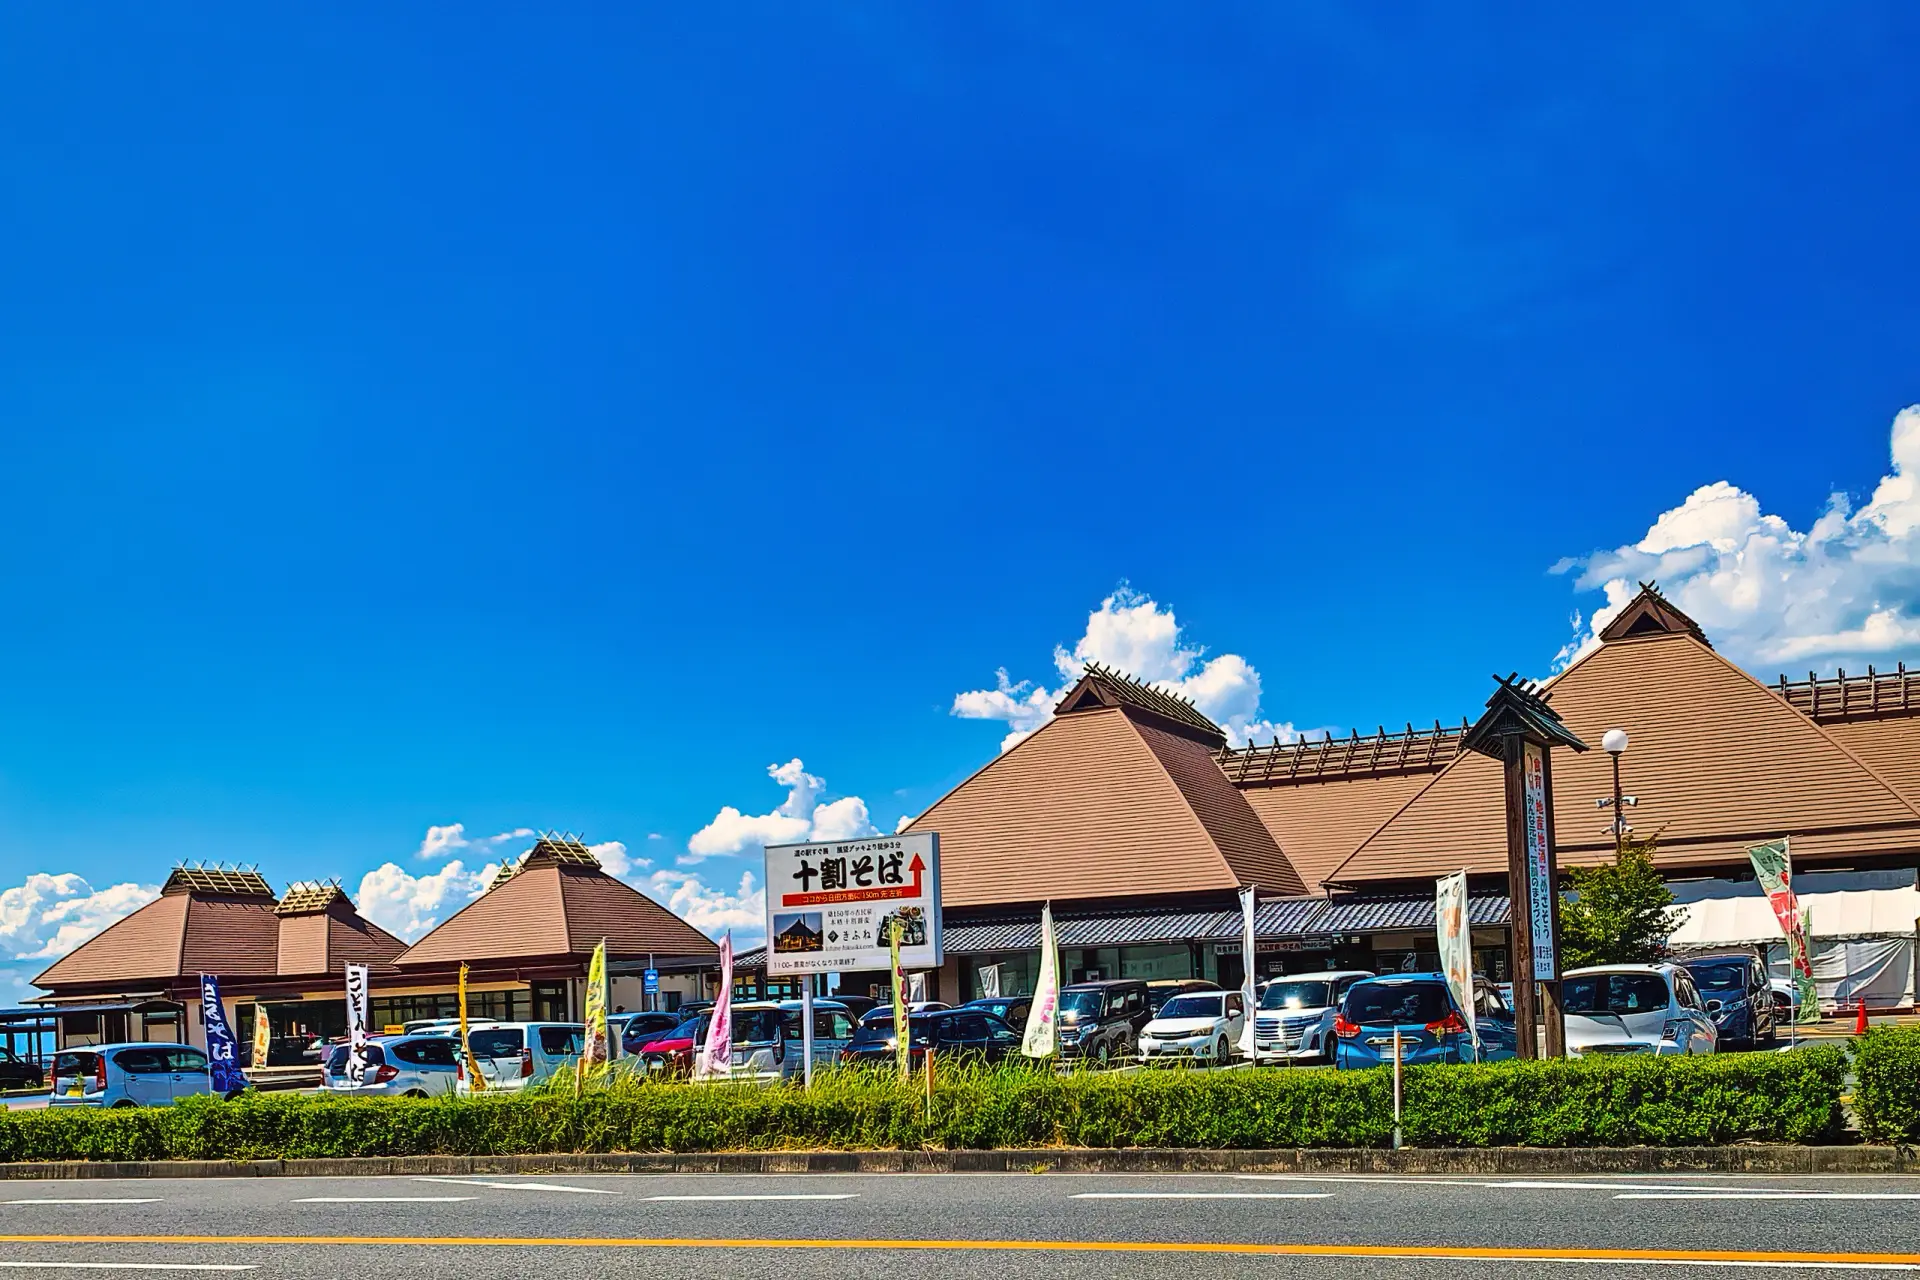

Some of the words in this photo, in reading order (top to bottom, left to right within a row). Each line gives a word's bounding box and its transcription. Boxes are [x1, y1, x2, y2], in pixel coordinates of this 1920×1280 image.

[793, 851, 905, 892] 十割そば
[862, 891, 879, 900] 150m
[842, 929, 872, 942] きふね
